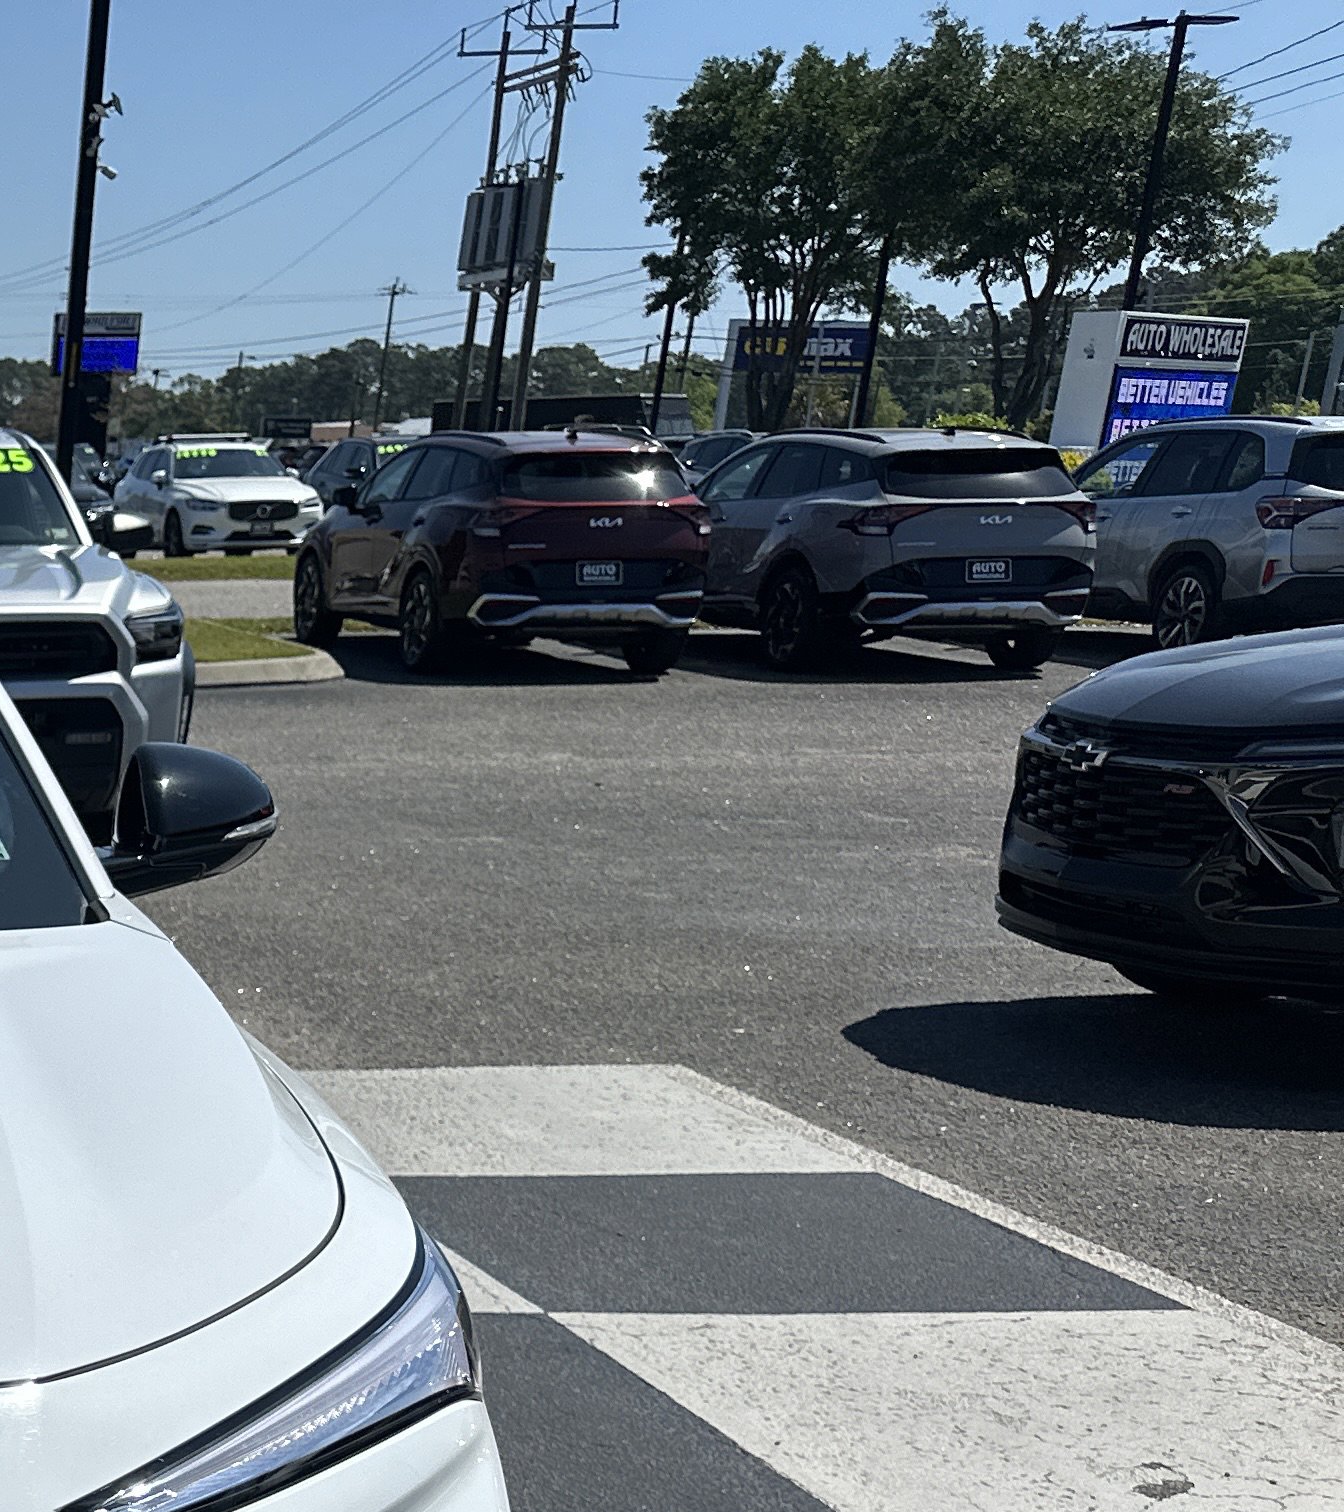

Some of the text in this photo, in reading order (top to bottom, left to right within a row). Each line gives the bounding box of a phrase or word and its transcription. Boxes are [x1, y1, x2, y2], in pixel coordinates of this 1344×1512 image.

[1127, 322, 1244, 357] AUTO WHOLESALE
[1117, 378, 1228, 407] BETTER VEHICLES
[590, 518, 624, 528] KIA
[977, 516, 1013, 525] KIA
[583, 564, 617, 575] AUTO
[973, 562, 1006, 574] AUTO
